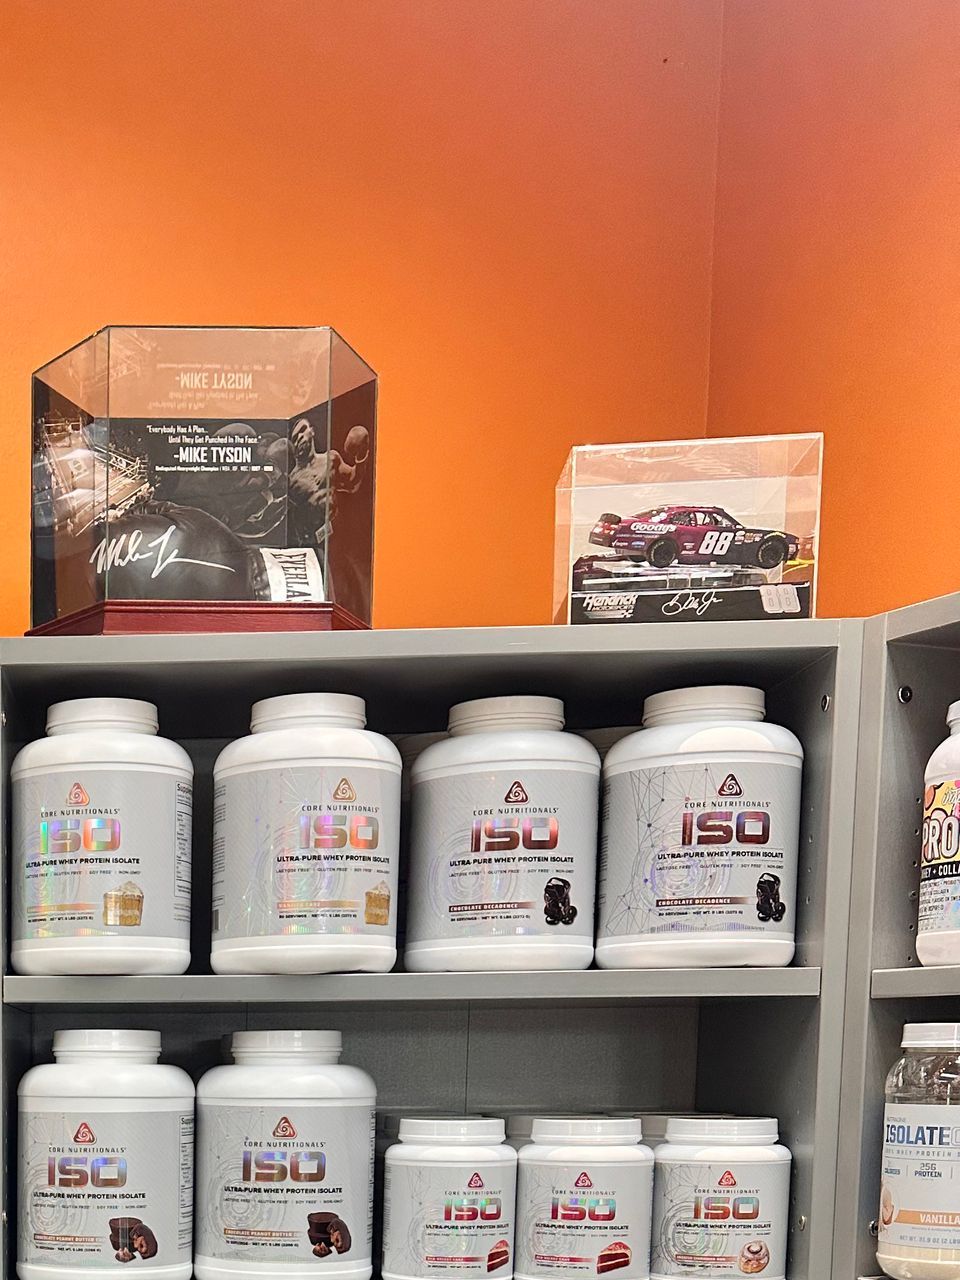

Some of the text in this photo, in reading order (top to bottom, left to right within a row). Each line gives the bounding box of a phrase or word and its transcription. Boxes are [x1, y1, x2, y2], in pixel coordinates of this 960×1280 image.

[146, 424, 176, 435] "Everybody
[178, 424, 187, 433] Has
[188, 424, 192, 433] A
[169, 435, 180, 444] Until
[182, 435, 194, 445] They
[195, 435, 204, 444] Get
[205, 435, 227, 444] Punched
[228, 435, 233, 443] In
[235, 435, 244, 443] The
[211, 447, 251, 463] TYSON
[699, 531, 734, 555] 88
[583, 594, 638, 608] Hendrick
[759, 584, 801, 613] 88
[497, 807, 559, 815] NUTRITIONALS
[708, 800, 769, 808] NUTRITIONALS
[41, 808, 119, 817] CORE NUTRITIONALS
[40, 818, 121, 854] ISO
[300, 815, 380, 849] ISO
[470, 816, 559, 853] ISO
[681, 811, 771, 846] ISO
[58, 858, 78, 866] WHEY
[79, 857, 110, 865] PROTEIN
[112, 856, 140, 865] ISOLATE
[494, 856, 516, 864] WHEY
[518, 856, 548, 864] PROTEIN
[550, 855, 574, 863] ISOLATE
[706, 851, 727, 859] WHEY
[729, 850, 760, 858] PROTEIN
[762, 850, 784, 859] ISOLATE
[47, 1156, 128, 1188] ISO
[242, 1151, 327, 1183] ISO
[914, 1170, 942, 1178] PROTEIN
[920, 1163, 936, 1171] 25G
[443, 1196, 502, 1221] ISO
[550, 1197, 616, 1221] ISO
[693, 1196, 760, 1220] ISO
